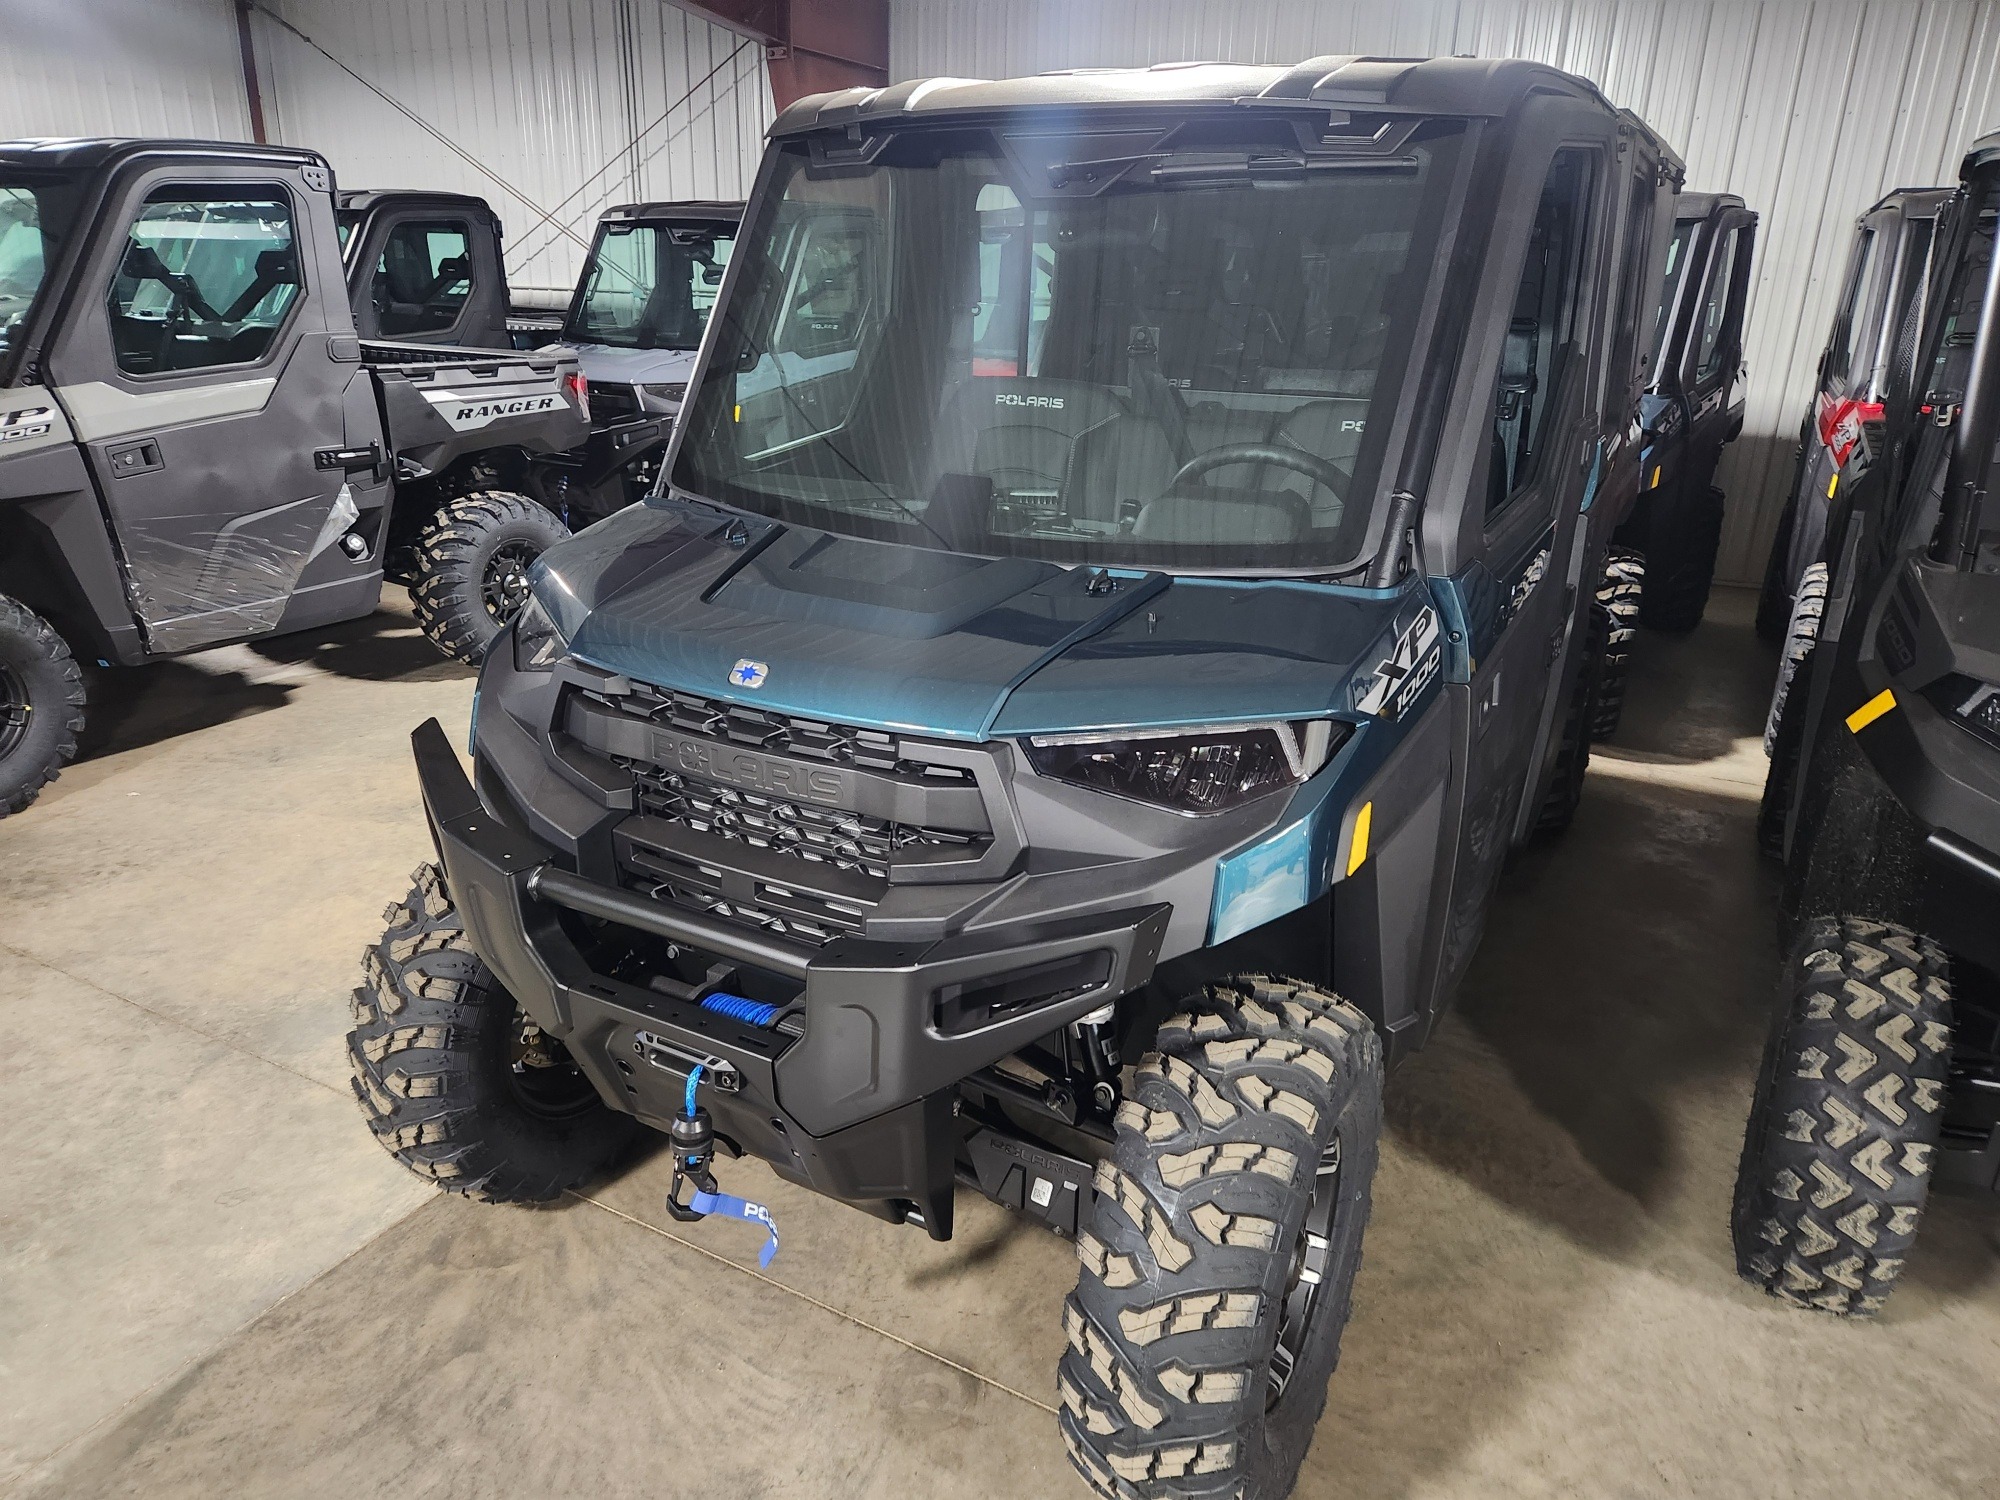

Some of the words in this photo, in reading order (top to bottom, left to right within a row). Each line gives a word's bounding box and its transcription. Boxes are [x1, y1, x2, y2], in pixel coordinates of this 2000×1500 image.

[0, 406, 50, 426] P
[456, 397, 554, 420] RANGER
[995, 394, 1064, 409] POLARIS
[1373, 604, 1435, 709] XP
[1397, 645, 1441, 712] 1000
[651, 731, 844, 804] POLARIS
[990, 1139, 1081, 1179] POLARIS
